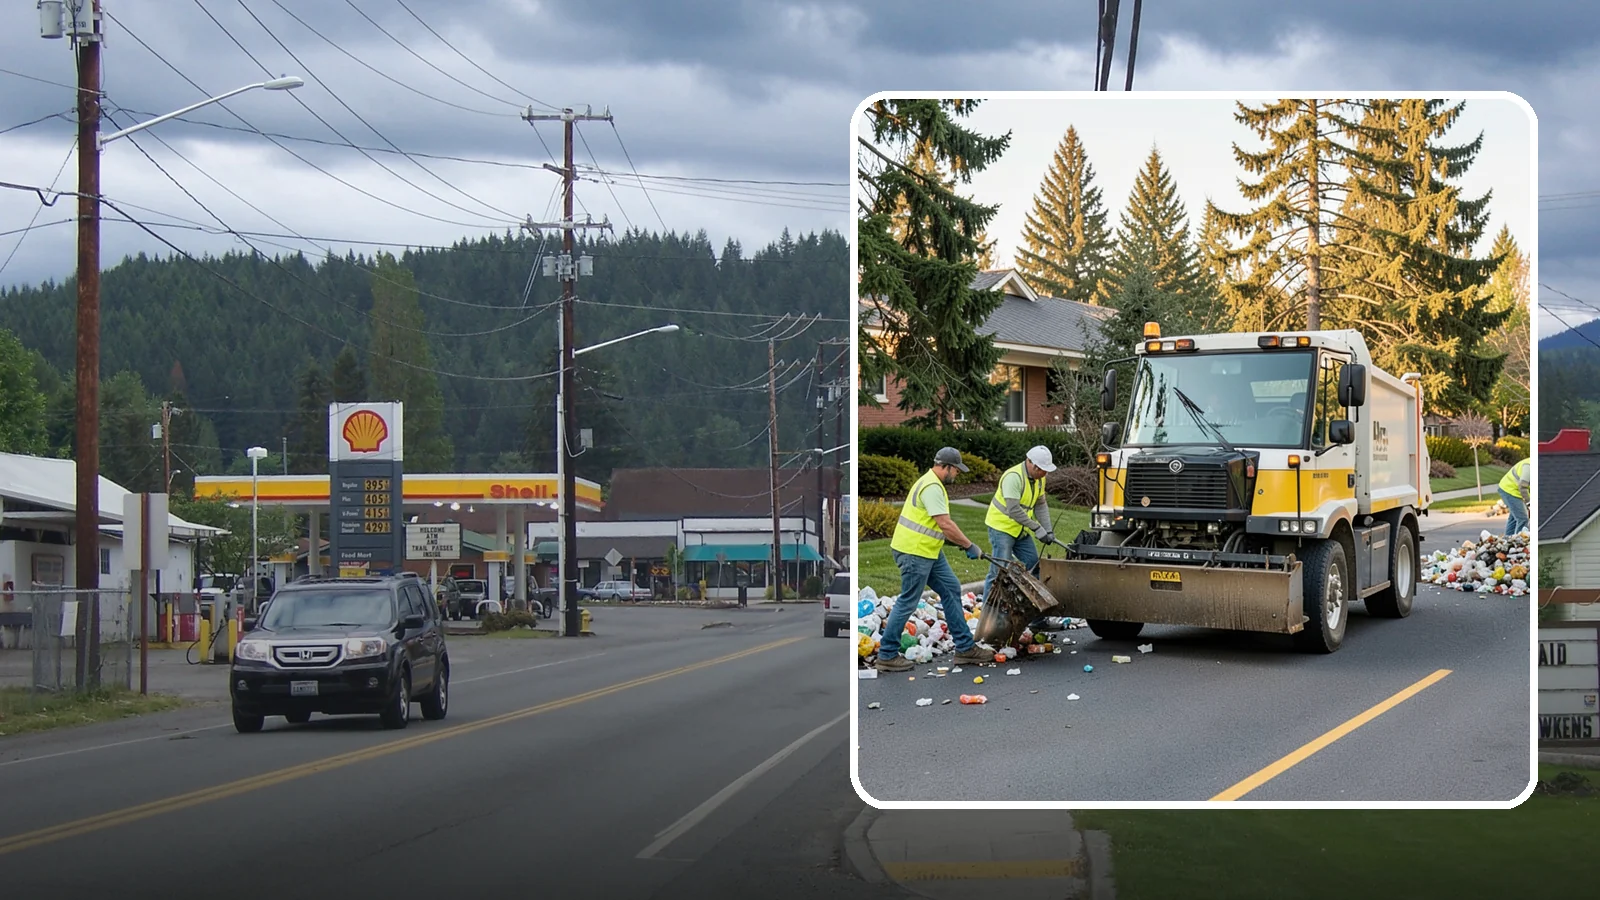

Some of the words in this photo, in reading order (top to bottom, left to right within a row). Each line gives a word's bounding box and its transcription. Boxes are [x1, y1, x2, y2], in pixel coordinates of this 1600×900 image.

[366, 480, 384, 490] 395
[490, 484, 547, 499] Shell
[366, 494, 384, 504] 405
[366, 508, 384, 518] 415
[366, 522, 384, 532] 429
[420, 526, 445, 534] WELCOME
